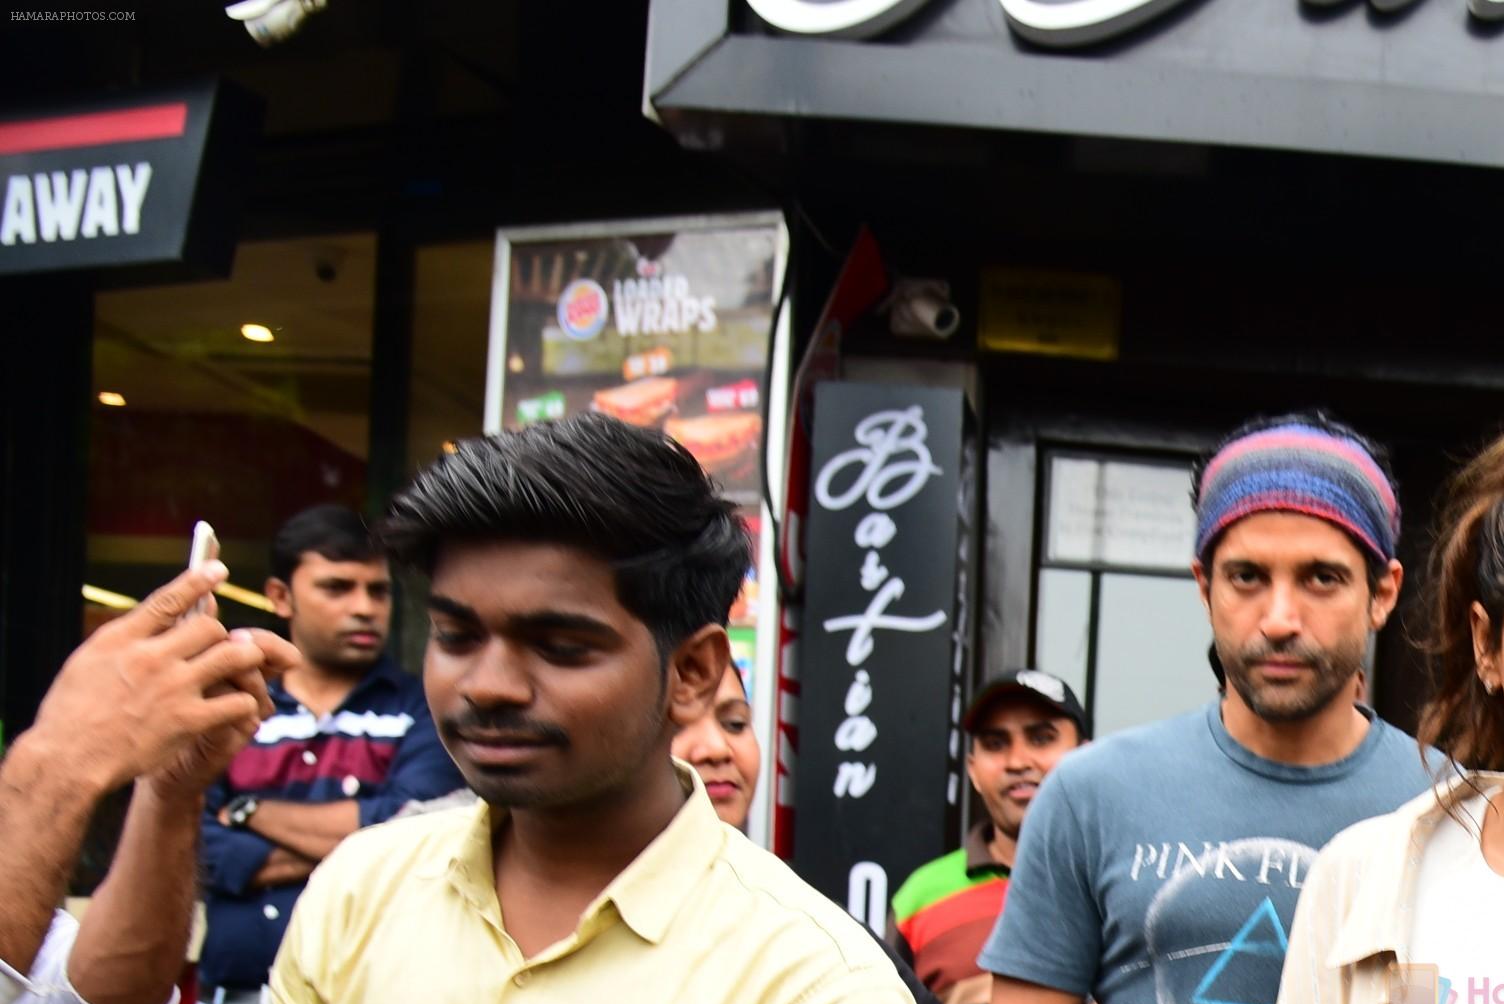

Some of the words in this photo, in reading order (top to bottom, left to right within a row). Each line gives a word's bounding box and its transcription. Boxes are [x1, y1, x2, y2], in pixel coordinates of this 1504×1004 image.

[0, 161, 153, 246] AWAY
[614, 296, 718, 336] WRAPS
[1130, 842, 1247, 882] PINK
